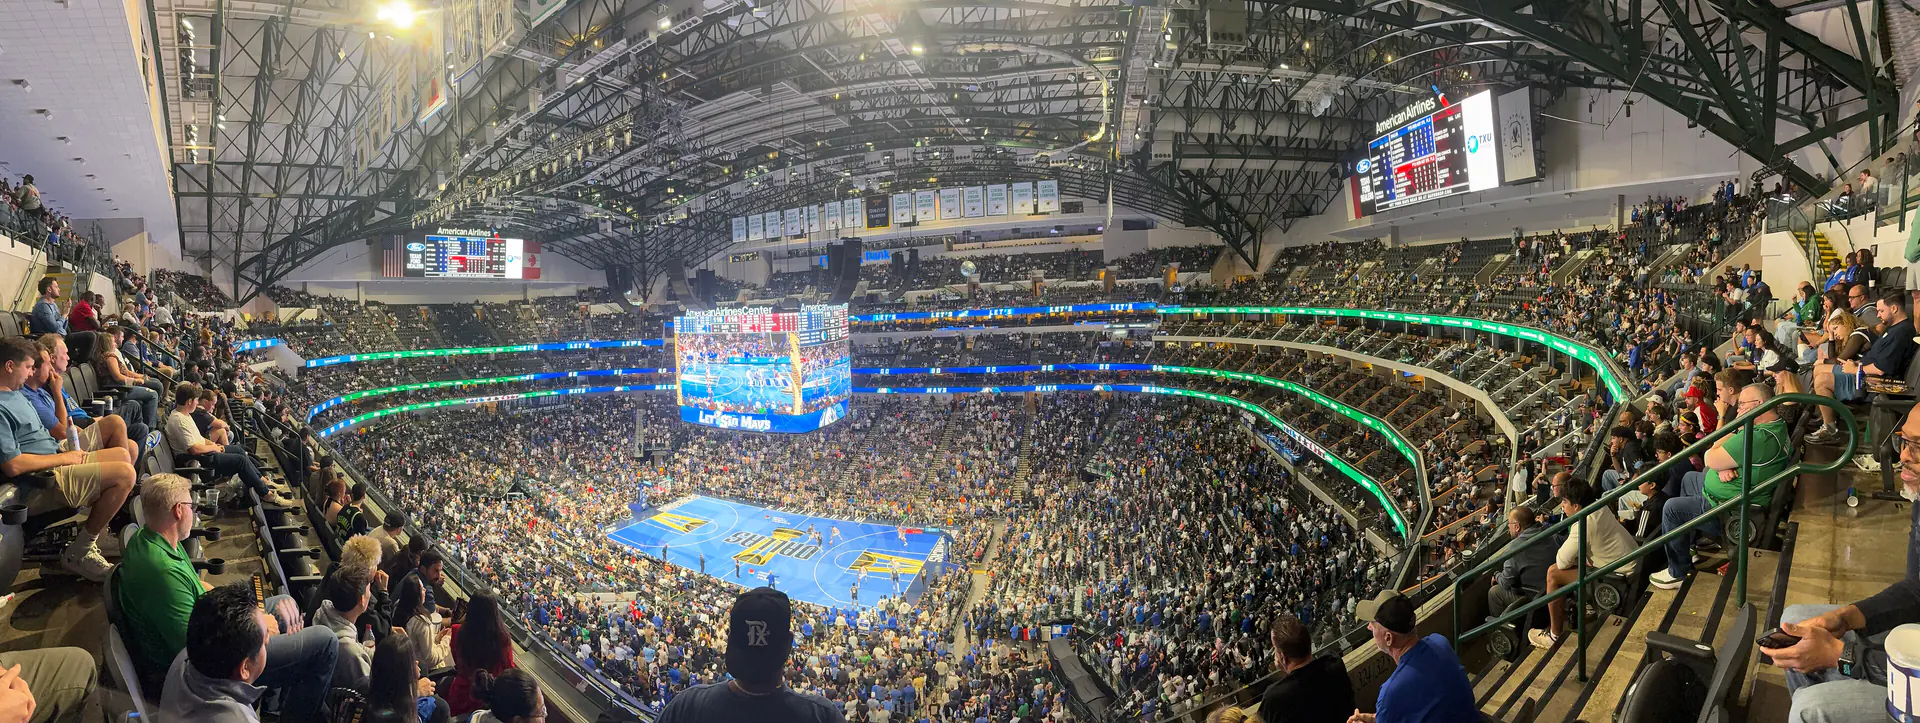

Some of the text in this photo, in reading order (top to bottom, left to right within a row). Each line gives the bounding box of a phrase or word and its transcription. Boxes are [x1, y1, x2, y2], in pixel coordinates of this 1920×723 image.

[1376, 97, 1436, 134] American Airlines
[1479, 132, 1492, 143] TXU
[437, 227, 491, 237] American Airlines
[741, 415, 771, 430] MAVS
[722, 531, 819, 561] DALLAS
[1612, 617, 1622, 627] B
